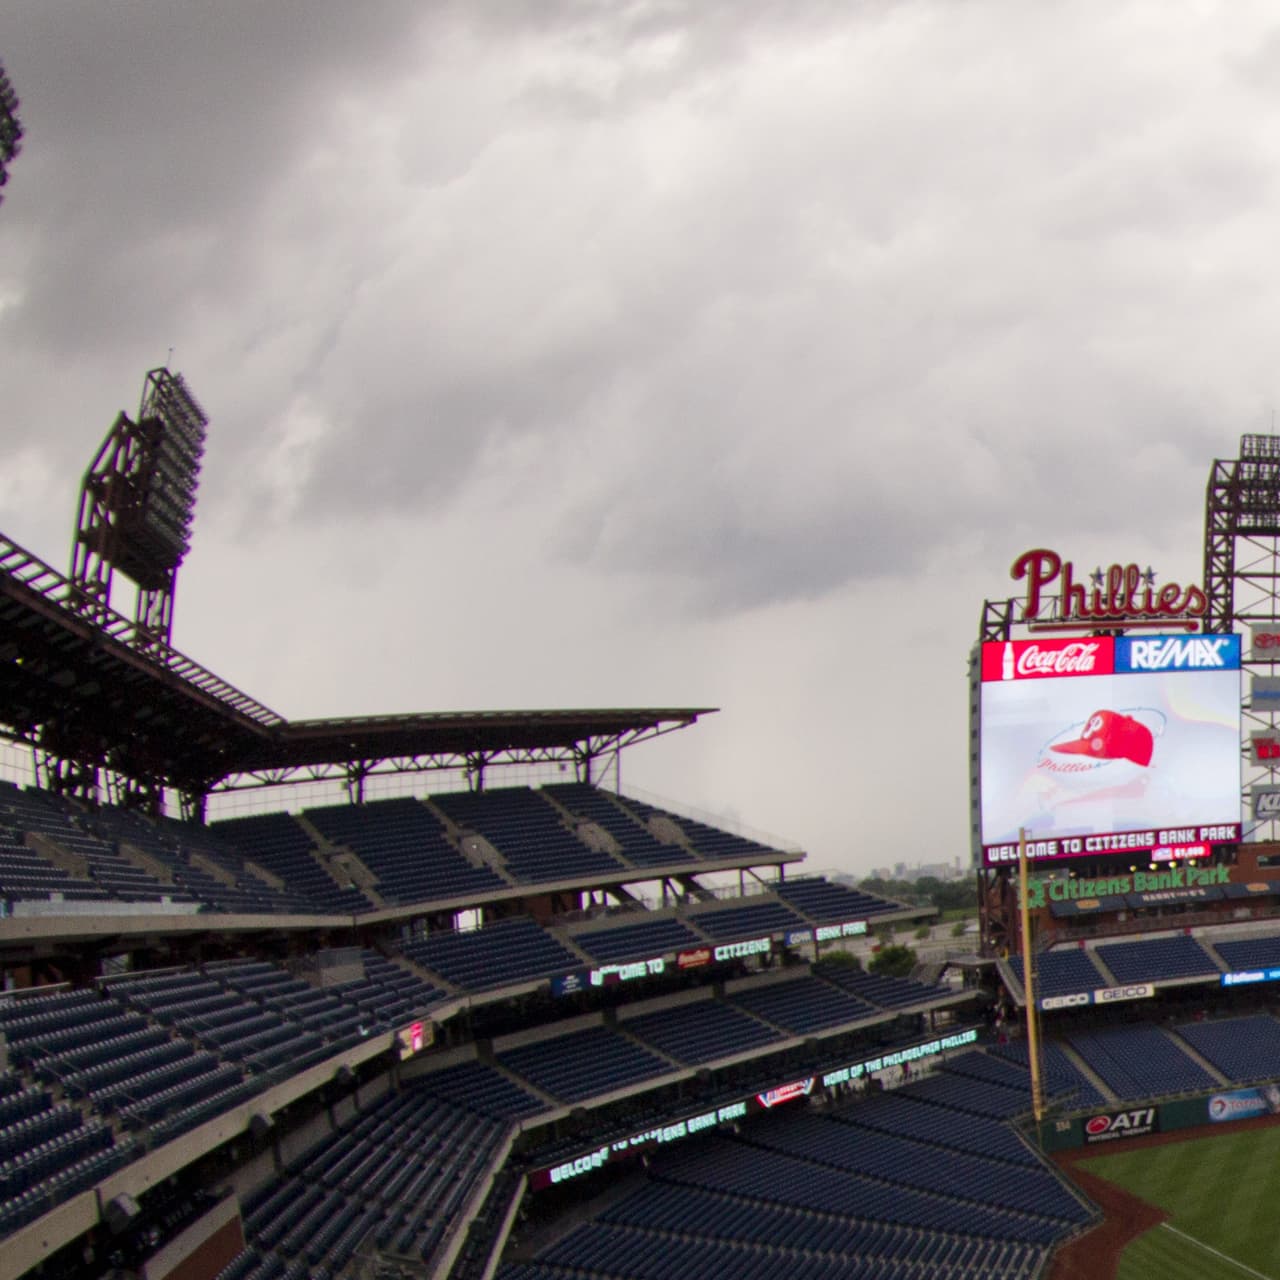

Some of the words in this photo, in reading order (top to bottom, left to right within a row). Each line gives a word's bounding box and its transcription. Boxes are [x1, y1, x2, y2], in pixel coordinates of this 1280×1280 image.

[1010, 549, 1208, 619] Phillies
[1017, 643, 1099, 674] Coca-Cola
[1037, 758, 1092, 772] Phillies
[1064, 840, 1081, 853] TO
[1086, 832, 1154, 851] CITIZENS
[1160, 829, 1194, 844] BANK
[1200, 826, 1235, 840] PARK
[1050, 877, 1130, 900] Citizens
[1134, 868, 1184, 892] Bank
[1187, 863, 1230, 884] Park
[816, 924, 841, 941] BANK
[842, 920, 867, 936] PARK
[715, 937, 772, 961] CITIZENS
[590, 961, 647, 985] WOME
[647, 957, 665, 974] TO
[1103, 986, 1147, 1000] GEICO
[823, 1068, 849, 1087] HOME
[851, 1064, 864, 1078] OF
[865, 1059, 882, 1073] THE
[883, 1040, 940, 1068] PHILADELPHIA
[941, 1029, 977, 1050] PHILLIES
[688, 1111, 717, 1133] BANK
[718, 1102, 746, 1122] PARK
[1109, 1108, 1154, 1131] ATI
